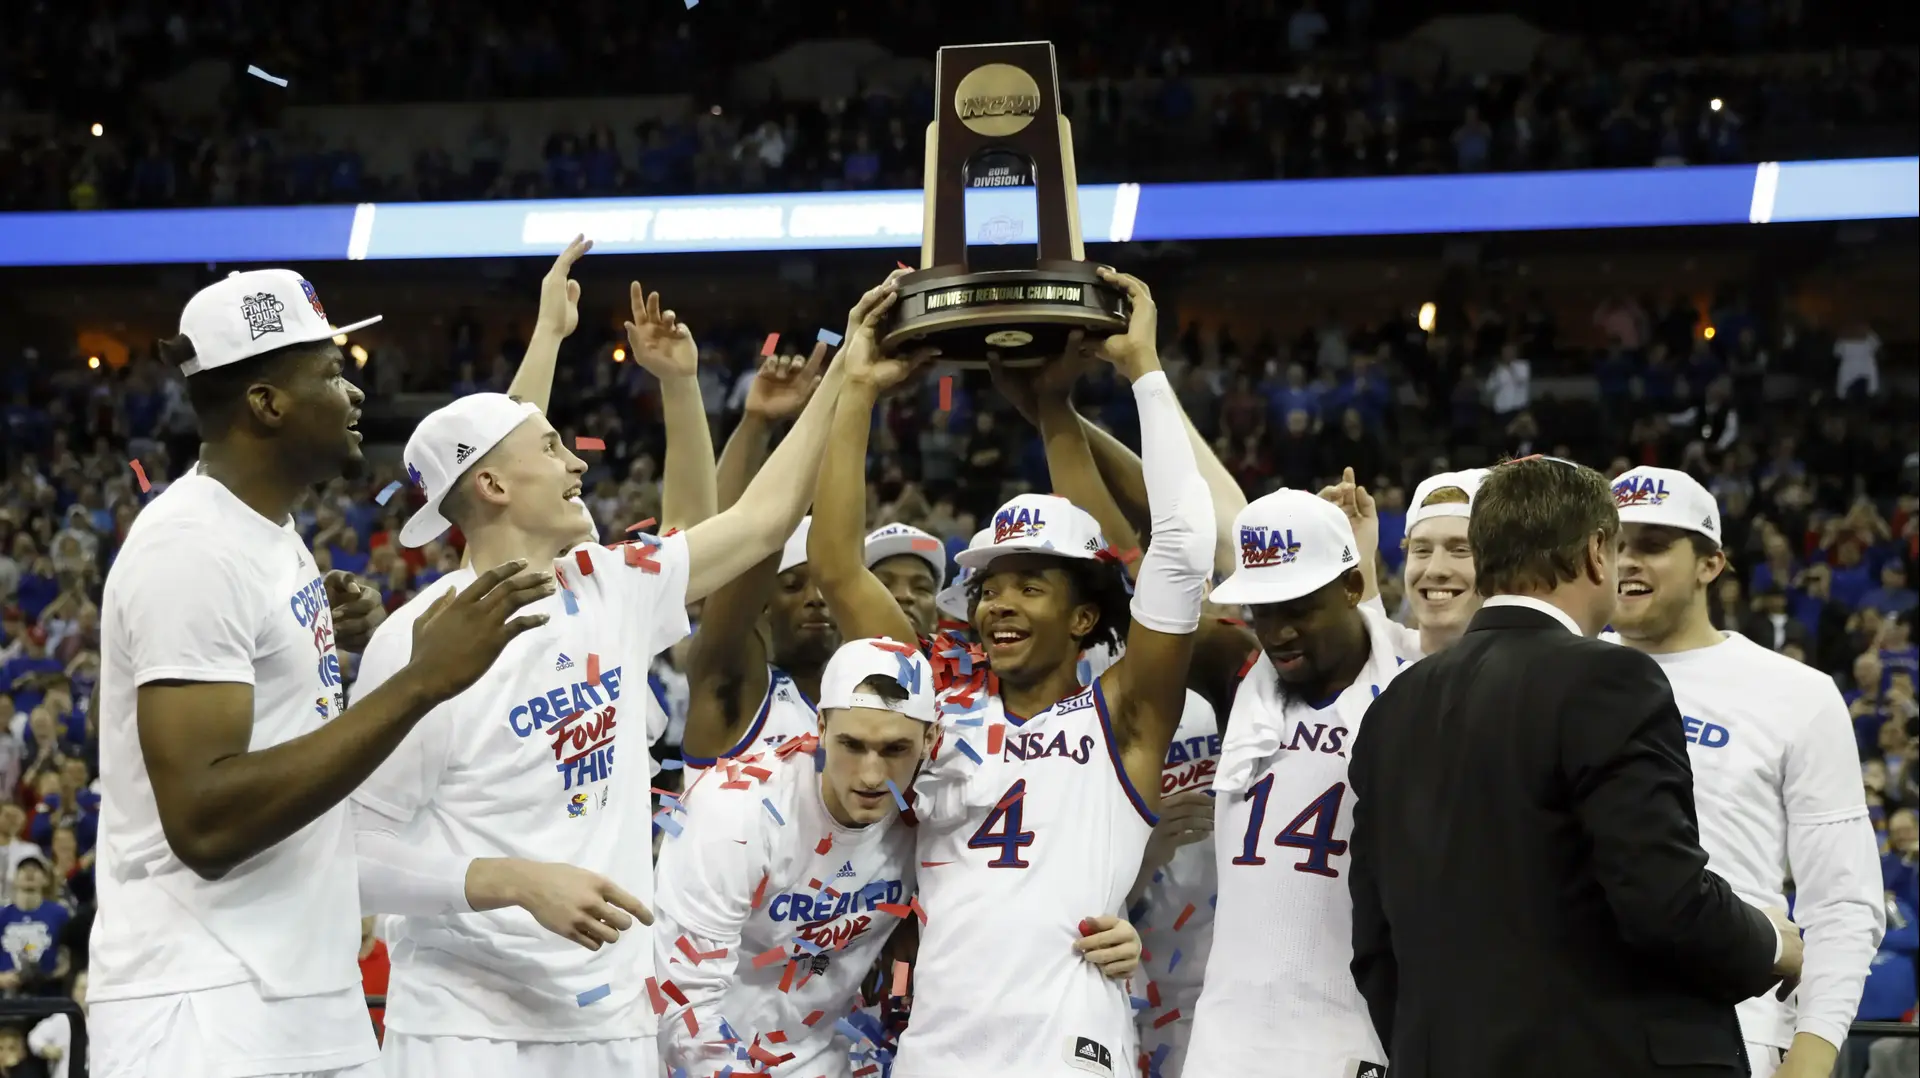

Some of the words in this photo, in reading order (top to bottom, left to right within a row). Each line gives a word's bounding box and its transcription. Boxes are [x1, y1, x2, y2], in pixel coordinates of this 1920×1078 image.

[963, 95, 1037, 119] NCAA
[973, 175, 1019, 188] DIVISION
[1020, 175, 1026, 186] I
[241, 299, 274, 319] FINAL
[927, 289, 974, 310] MIDWEST
[975, 286, 1025, 302] REGIONAL
[1026, 285, 1081, 302] CHAMPION
[249, 308, 280, 326] FOUR
[546, 705, 617, 762] FOUR
[1160, 760, 1217, 794] OUR
[967, 778, 1035, 868] 4
[1231, 772, 1348, 878] 14
